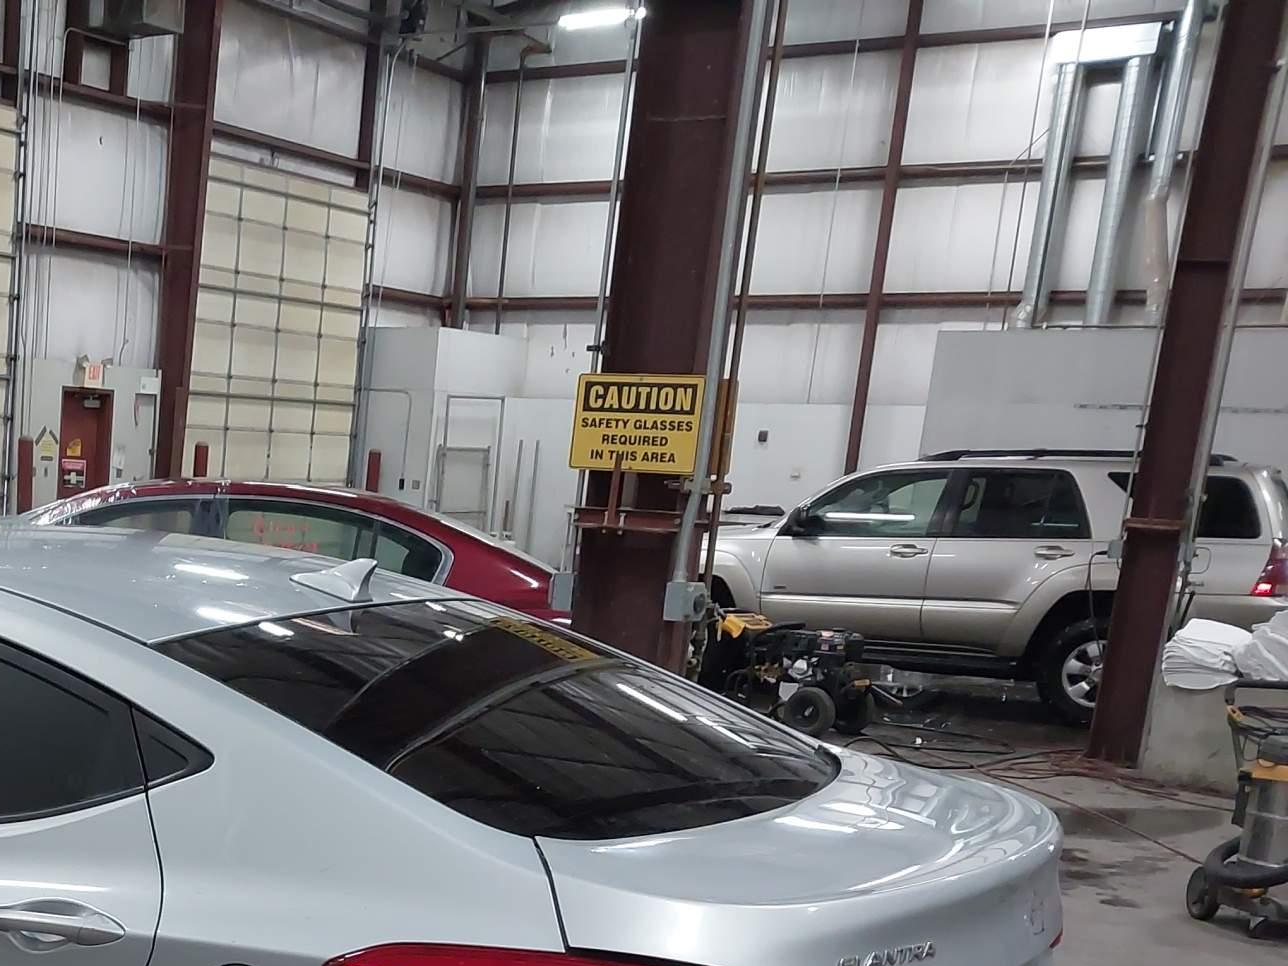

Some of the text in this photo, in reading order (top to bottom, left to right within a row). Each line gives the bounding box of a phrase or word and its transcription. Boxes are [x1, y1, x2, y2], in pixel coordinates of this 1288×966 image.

[588, 385, 693, 411] CAUTION
[581, 417, 693, 432] SAFETY GLASSES
[601, 434, 669, 447] REQUIRED
[590, 449, 676, 463] IN THIS AREA
